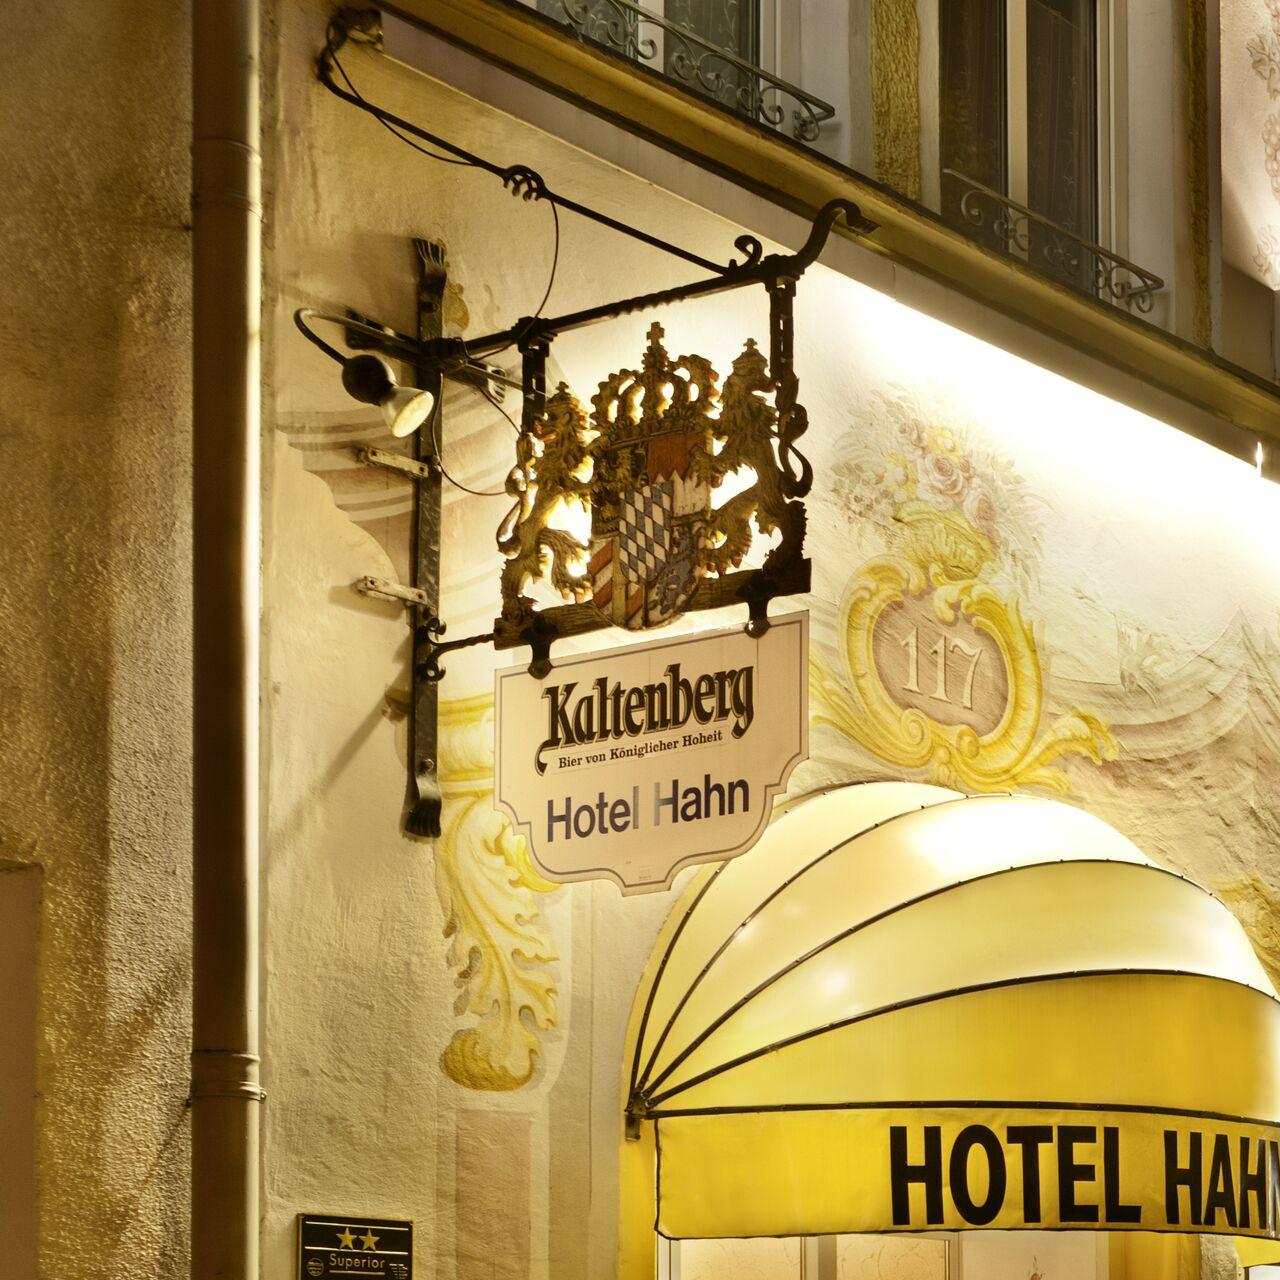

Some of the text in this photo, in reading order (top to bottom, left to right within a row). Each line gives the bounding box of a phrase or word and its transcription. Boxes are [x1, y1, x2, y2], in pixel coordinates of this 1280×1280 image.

[902, 625, 982, 711] 117
[534, 663, 754, 776] Kaltenberg
[558, 729, 724, 769] Bier von Königlicher Hoheit
[547, 774, 750, 843] Hotel Hahn
[889, 1124, 1142, 1226] HOTEL
[329, 1253, 386, 1270] Superior
